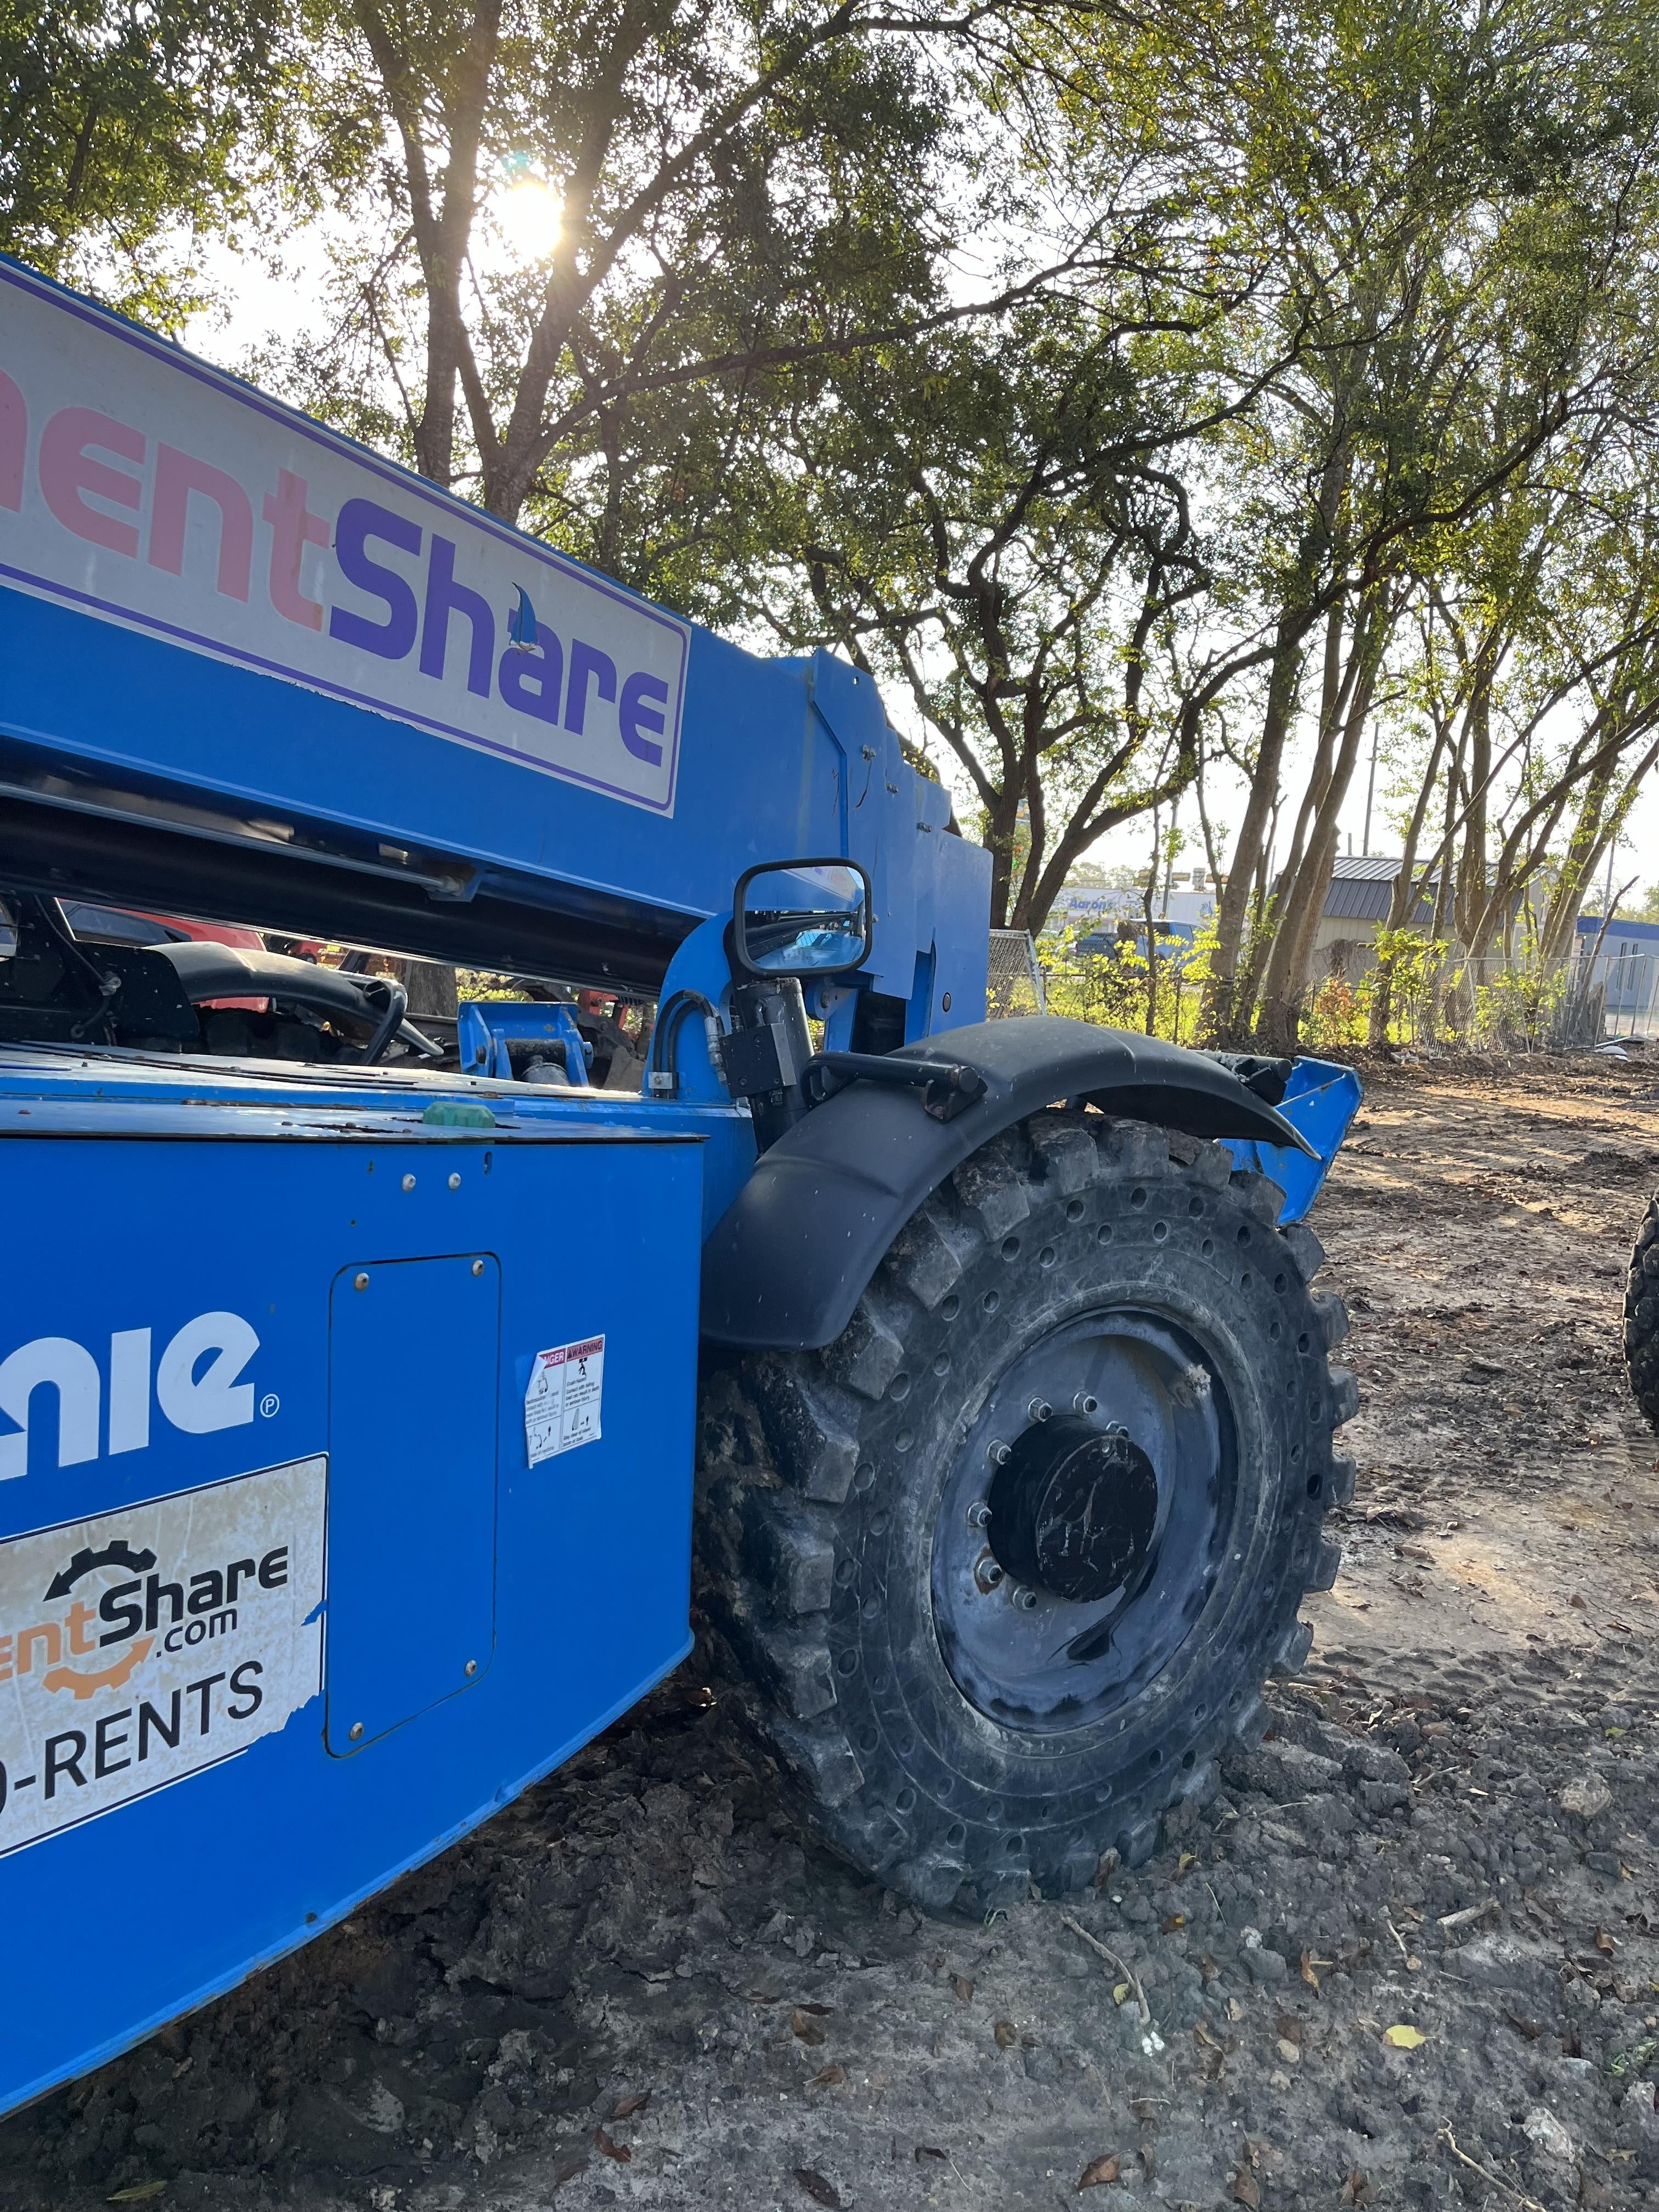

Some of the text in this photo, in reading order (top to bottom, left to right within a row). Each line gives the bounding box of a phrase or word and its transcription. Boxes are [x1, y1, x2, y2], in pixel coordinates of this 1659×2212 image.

[0, 369, 668, 766] entShare
[0, 1312, 260, 1481] nie
[544, 1351, 565, 1365] NGER
[572, 1340, 602, 1357] WARNING
[156, 1609, 237, 1658] .com
[0, 1661, 263, 1812] -RENTS
